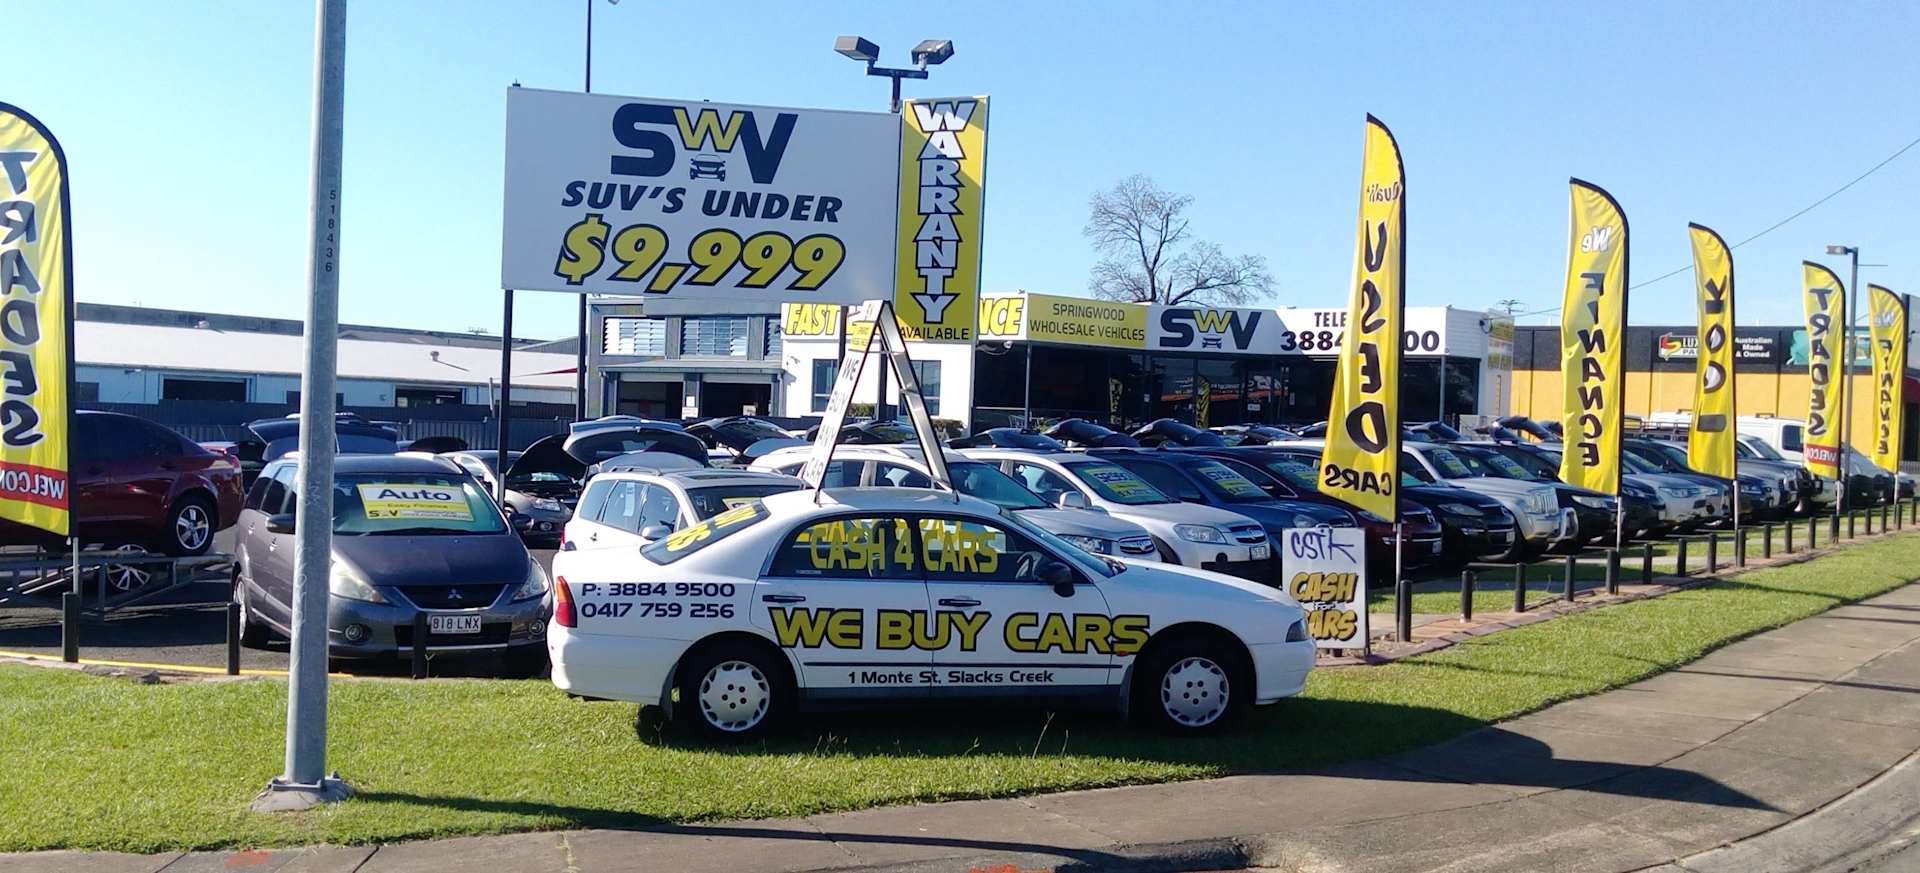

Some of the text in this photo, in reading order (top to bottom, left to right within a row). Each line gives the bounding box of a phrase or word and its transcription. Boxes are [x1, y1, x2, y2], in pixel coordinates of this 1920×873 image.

[562, 180, 843, 223] SUV'S UNDER
[910, 101, 977, 324] WARRANTY
[324, 189, 337, 273] 518436
[554, 213, 846, 294] $9,999
[785, 303, 841, 336] FAST
[980, 297, 1025, 336] NCE
[1052, 303, 1125, 321] SPRINGWOOD
[1314, 311, 1347, 327] TELE
[900, 326, 969, 340] AVAILABLE
[1029, 319, 1145, 341] WHOLESALE VEHICLES
[1734, 336, 1773, 344] Australian
[378, 488, 452, 501] Auto
[810, 527, 998, 573] CASH 4 CARS
[581, 582, 736, 598] P: 3884 9500
[1289, 571, 1358, 603] CASH
[581, 603, 735, 618] 0417 759 256
[431, 616, 481, 630] 818 LNX
[767, 606, 1150, 655] WE BUY CARS
[1308, 609, 1358, 641] ARS
[848, 671, 855, 684] 1
[861, 671, 913, 684] Monte
[948, 670, 1003, 684] Slacks
[1009, 670, 1054, 683] Creek
